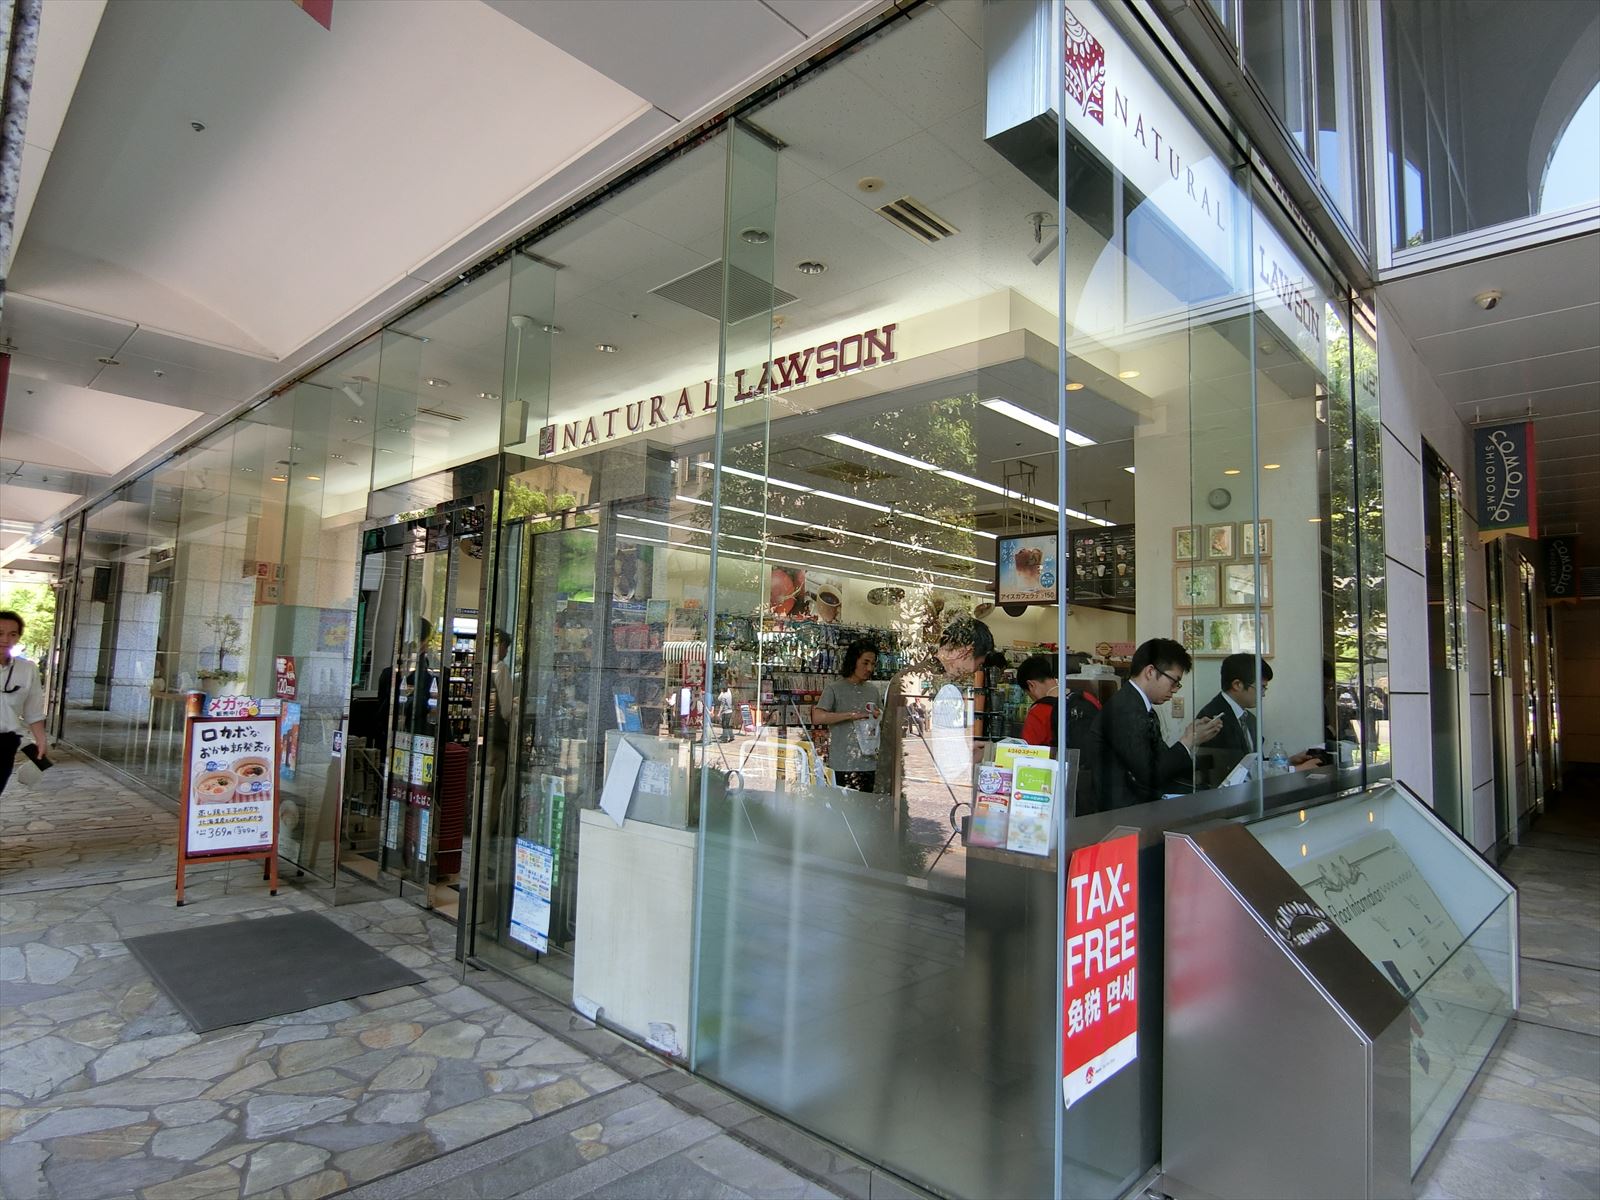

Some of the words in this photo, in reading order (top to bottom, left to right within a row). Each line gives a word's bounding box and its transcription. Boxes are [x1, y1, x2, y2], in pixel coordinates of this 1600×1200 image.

[1114, 86, 1225, 231] NATURAL
[1260, 245, 1320, 343] LAWSON
[562, 379, 718, 450] NATURAL
[734, 323, 896, 401] LAWSON
[1485, 445, 1497, 511] SHIODOME
[1488, 430, 1523, 522] COMODIO
[202, 725, 260, 742] ロカボな
[1070, 863, 1130, 924] TAX-
[1066, 912, 1135, 988] FREE
[1067, 986, 1101, 1038] 免税
[1106, 967, 1135, 1016] 면세
